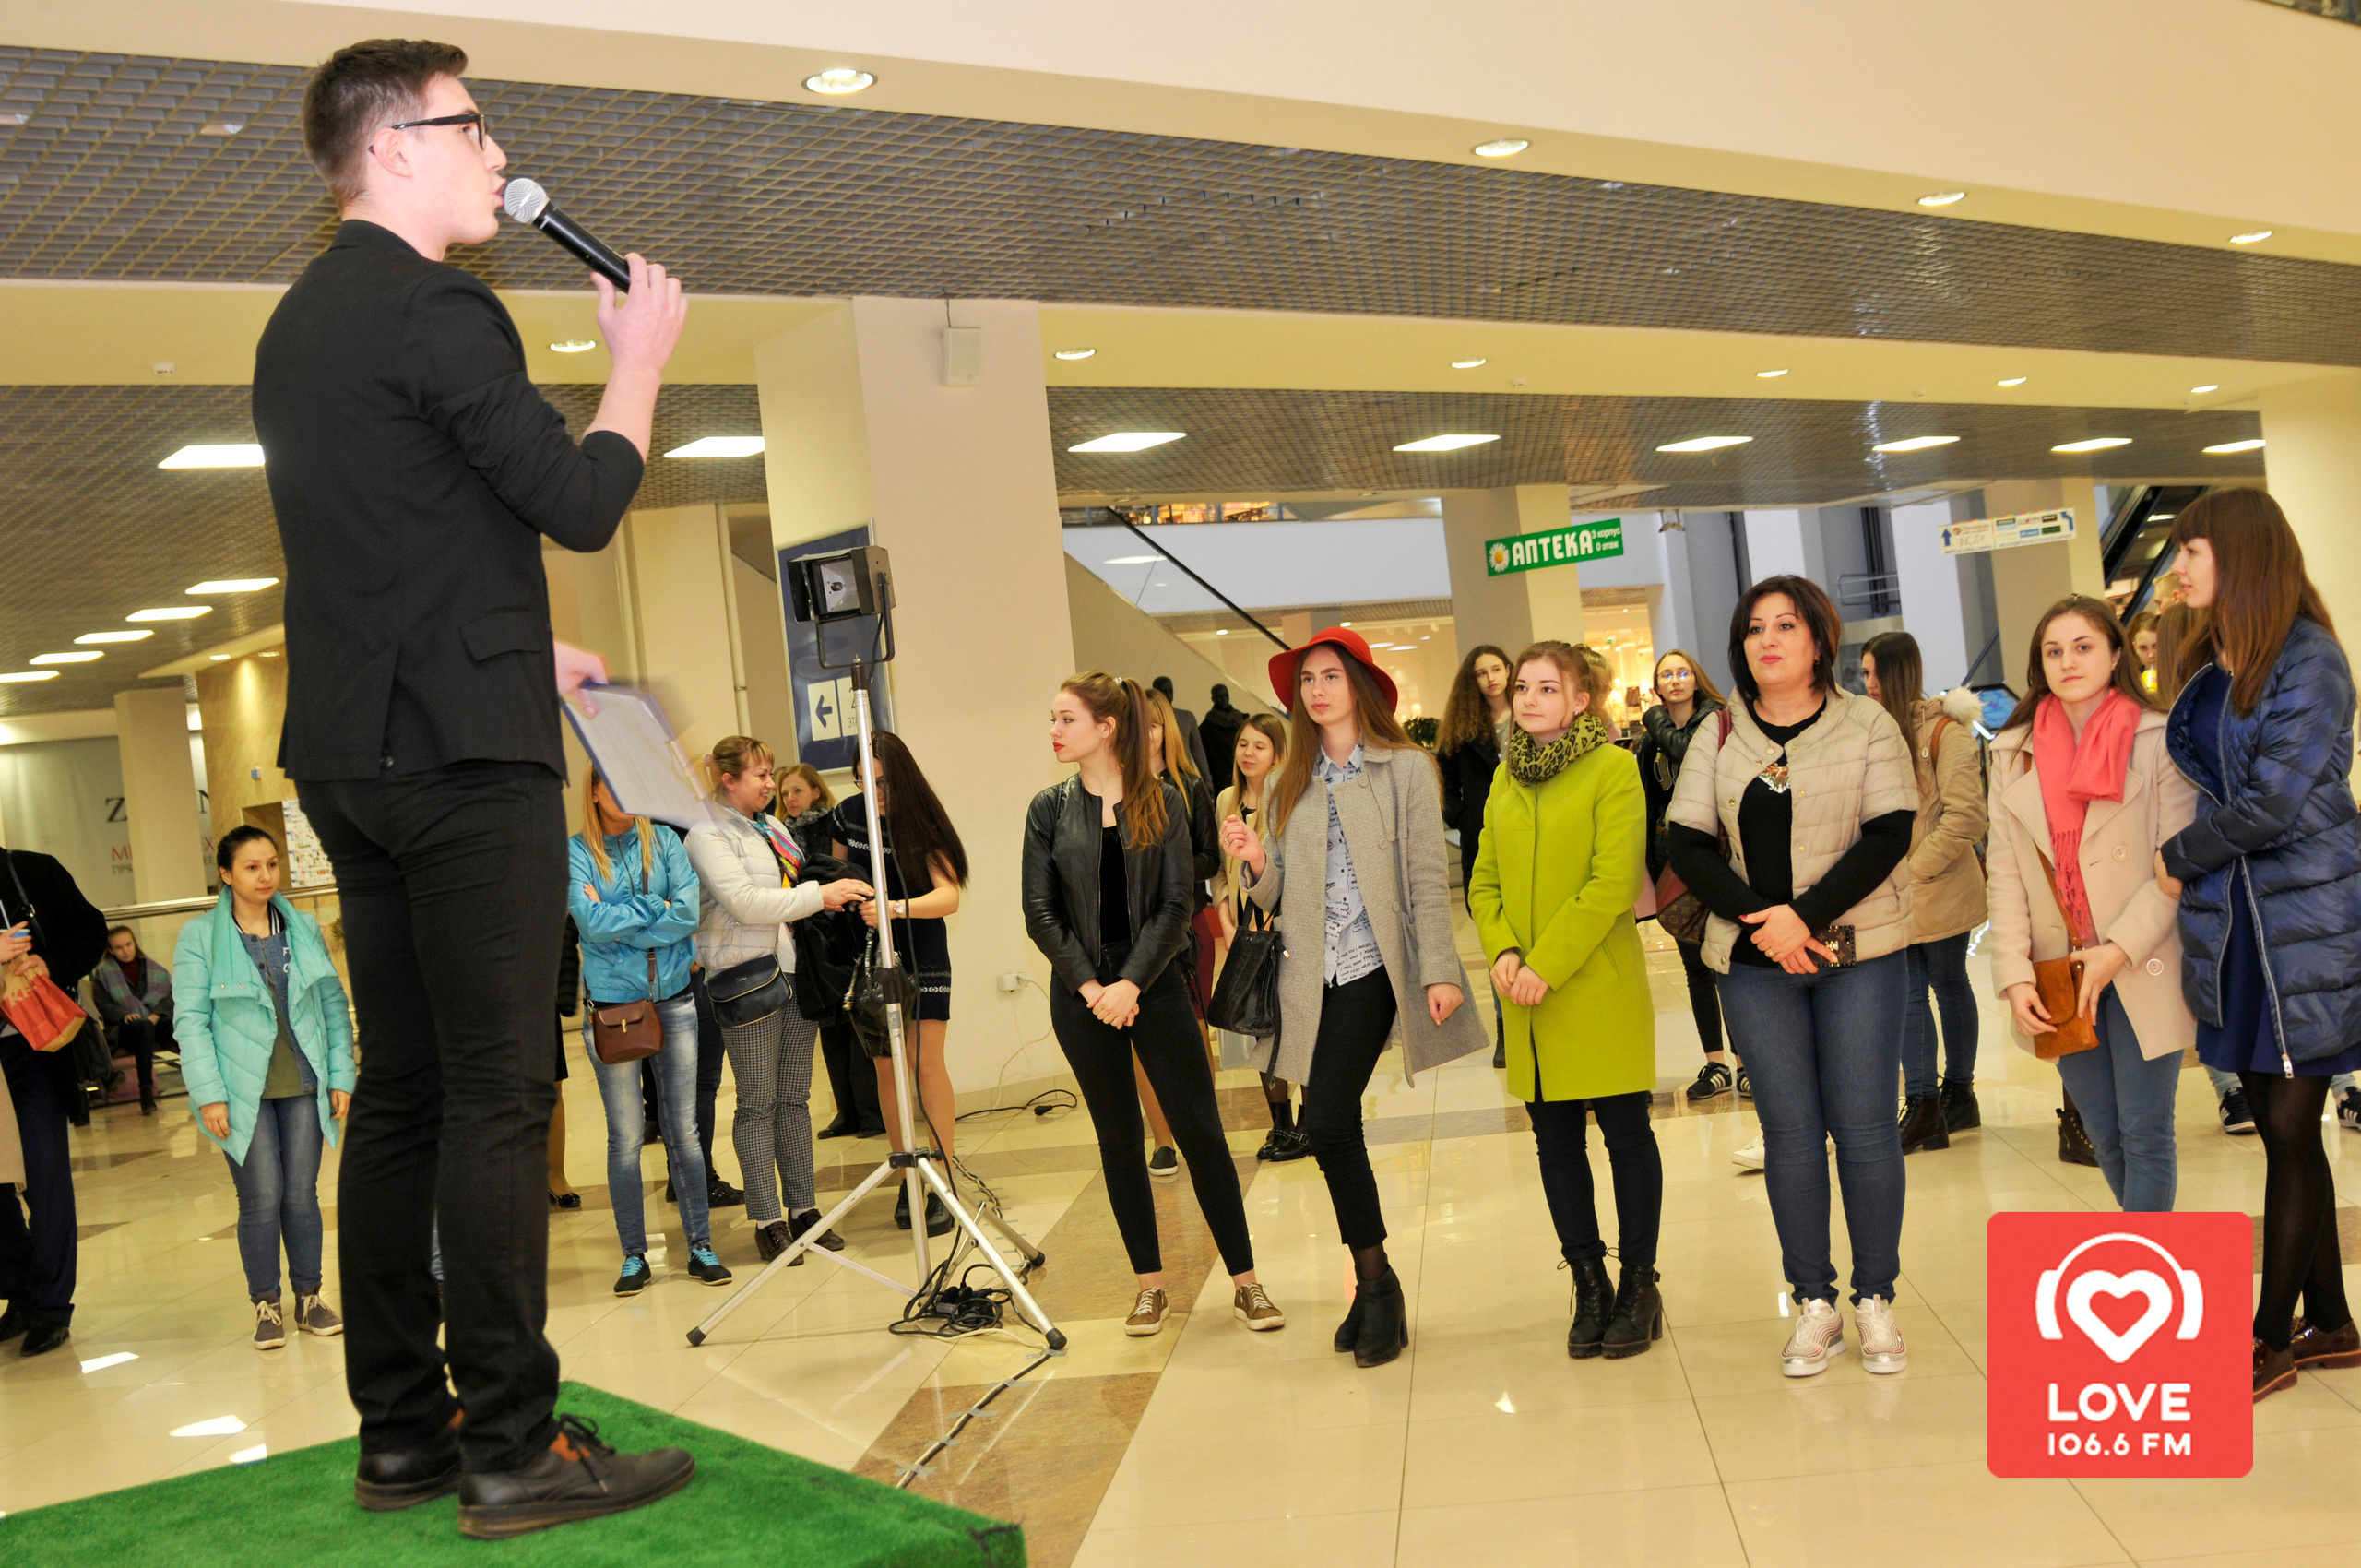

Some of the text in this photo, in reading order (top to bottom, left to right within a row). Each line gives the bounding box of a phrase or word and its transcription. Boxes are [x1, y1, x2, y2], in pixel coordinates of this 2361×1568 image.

[1591, 527, 1620, 539] 3 корпус
[1512, 529, 1593, 566] АПТЕКА
[1602, 540, 1619, 551] этаж
